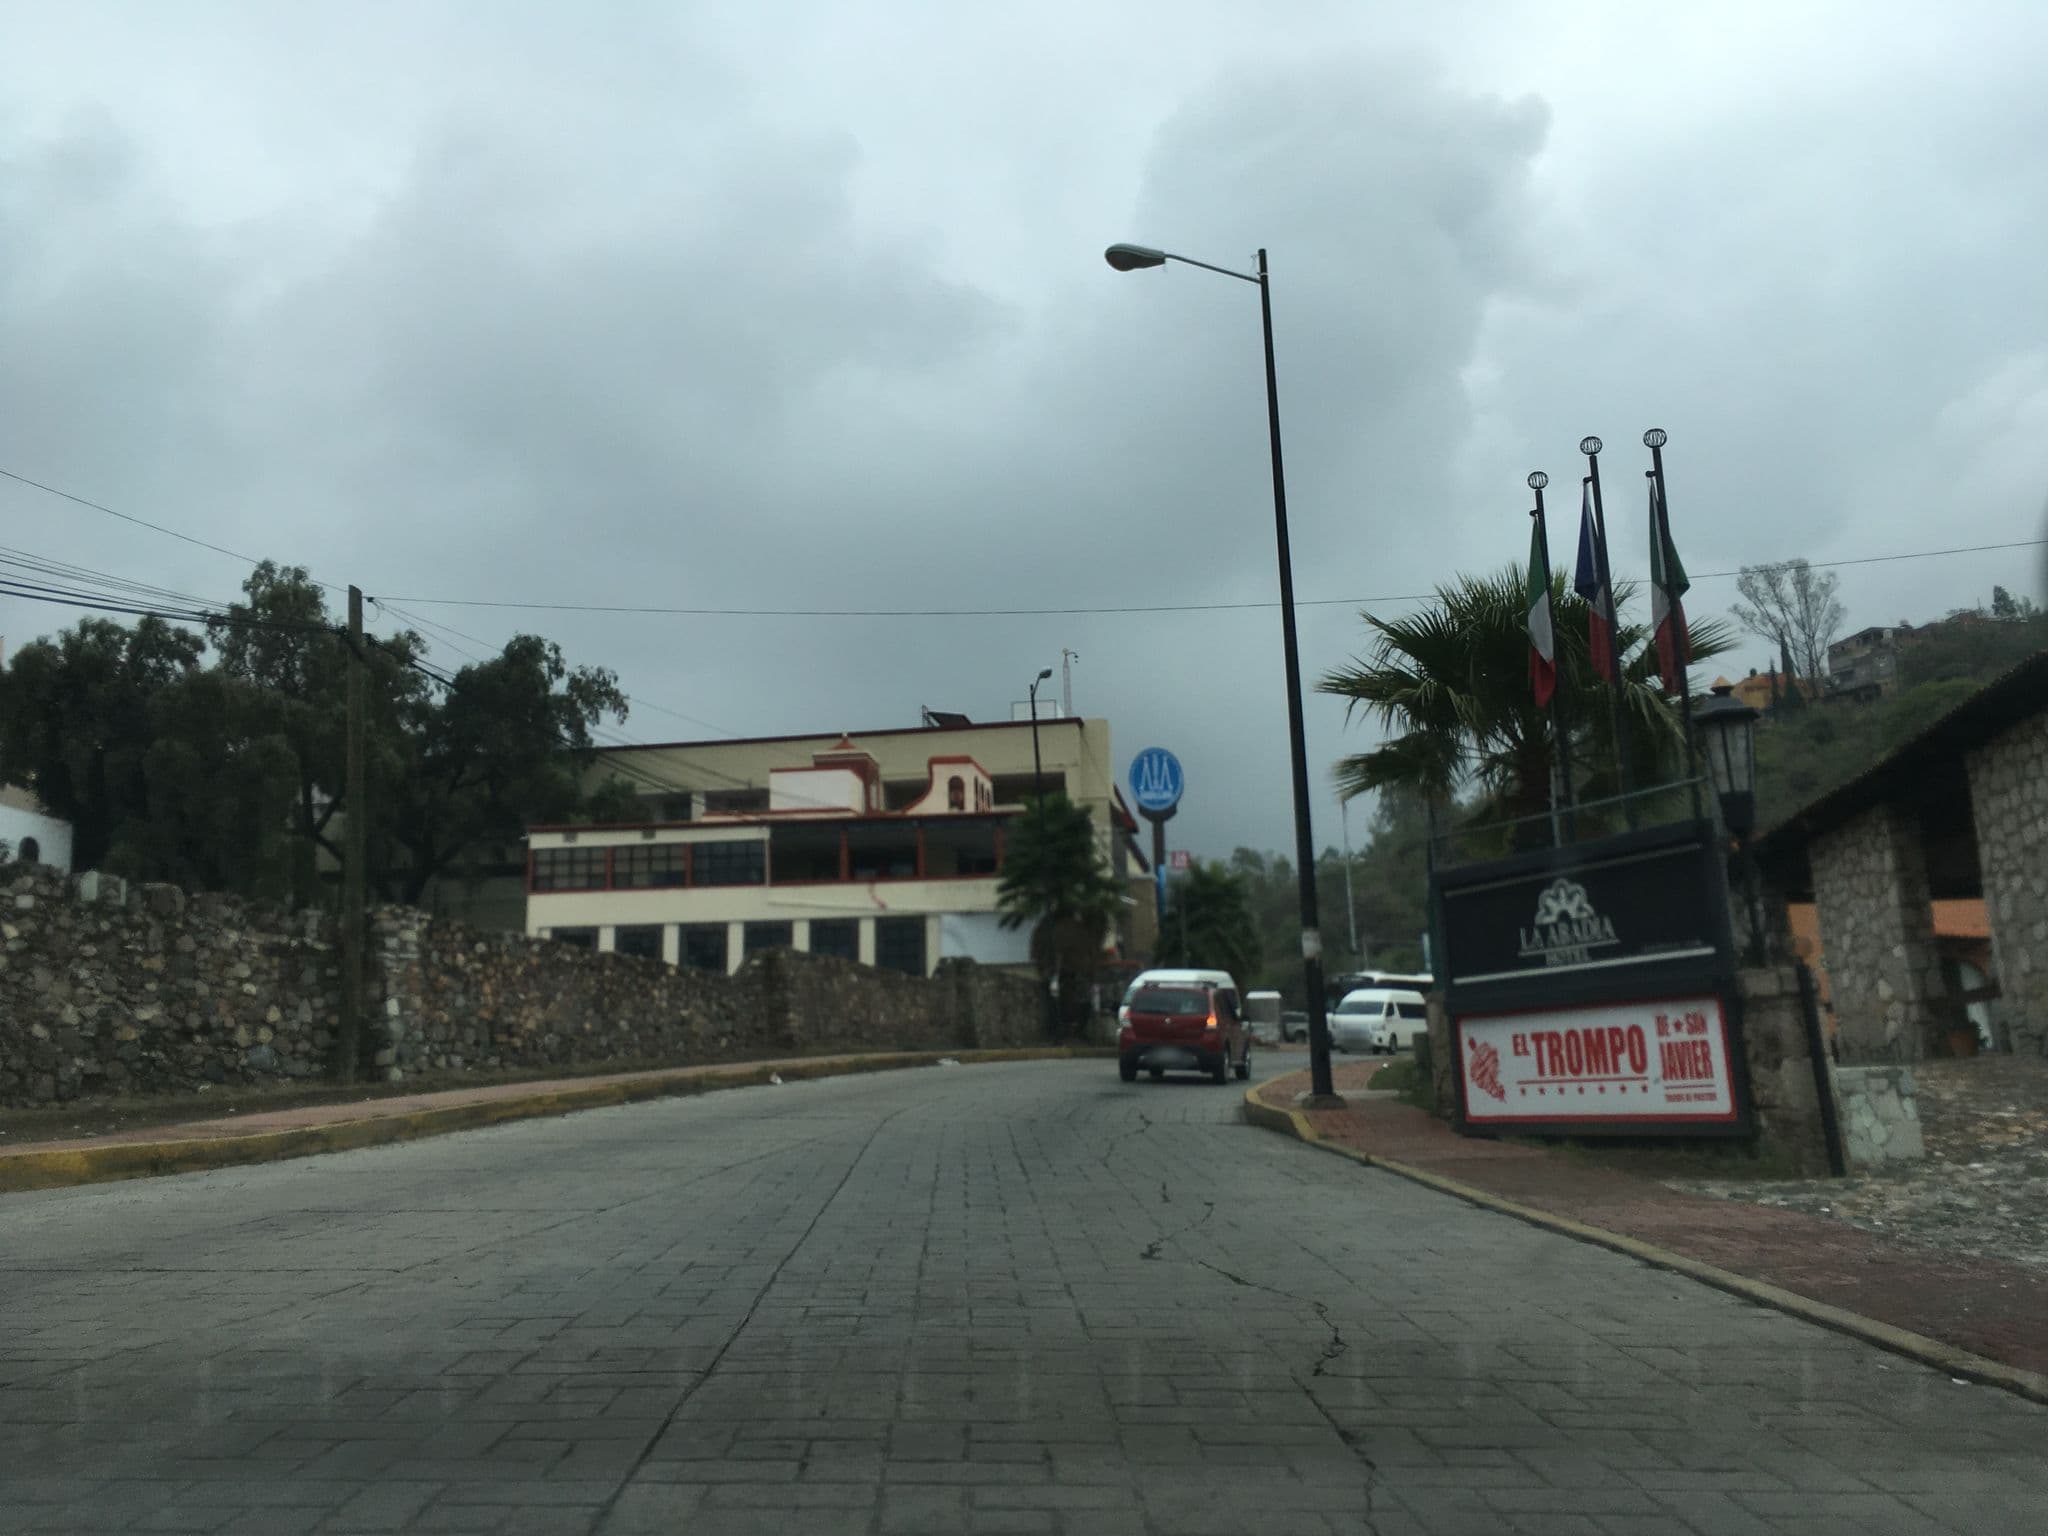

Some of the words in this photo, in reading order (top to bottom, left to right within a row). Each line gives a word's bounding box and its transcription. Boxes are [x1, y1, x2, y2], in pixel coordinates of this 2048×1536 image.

[1519, 927, 1544, 952] LA
[1655, 1014, 1670, 1036] DE
[1686, 1012, 1709, 1035] SAN
[1512, 1033, 1530, 1056] EL
[1531, 1024, 1649, 1077] TROMPO
[1660, 1039, 1715, 1081] JAVIER
